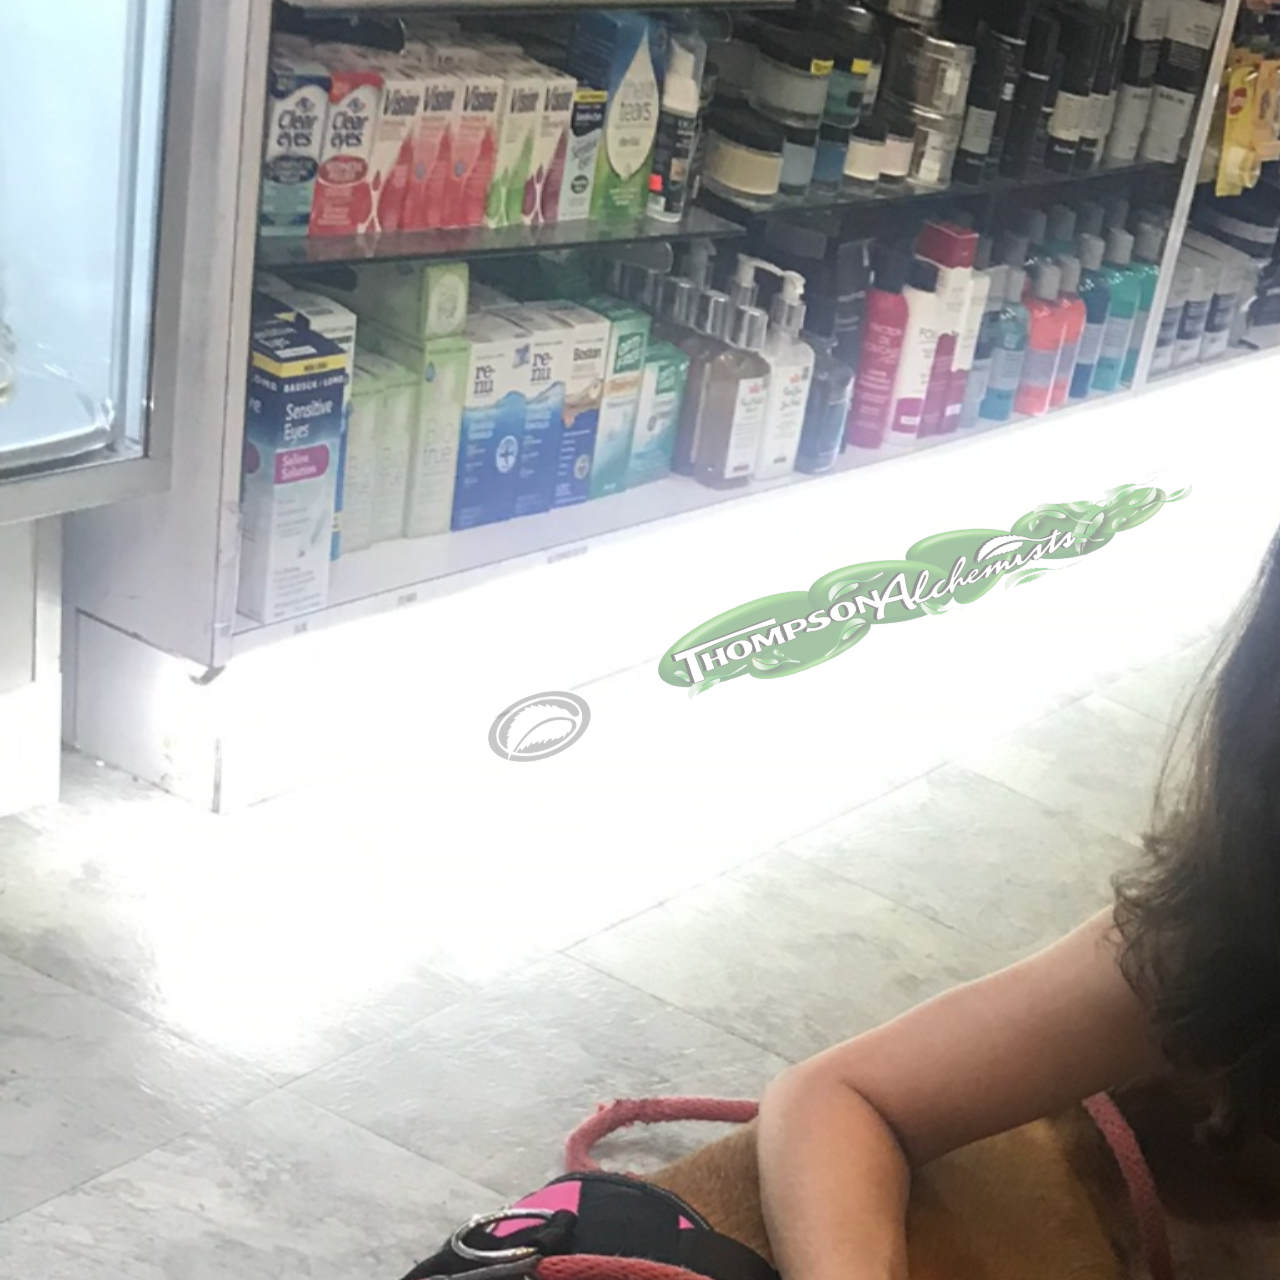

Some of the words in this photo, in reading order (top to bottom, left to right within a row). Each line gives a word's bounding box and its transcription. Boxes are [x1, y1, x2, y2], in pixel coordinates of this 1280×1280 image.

[383, 88, 420, 116] Visine
[423, 84, 455, 112] Visine
[463, 84, 498, 112] Visine
[511, 87, 539, 114] Visine
[544, 86, 573, 112] Visine
[278, 109, 318, 131] Clear
[332, 110, 368, 131] Clear
[285, 399, 334, 421] Sensitive
[284, 422, 310, 446] Eyes
[282, 453, 310, 467] Saline
[281, 464, 317, 481] Solution
